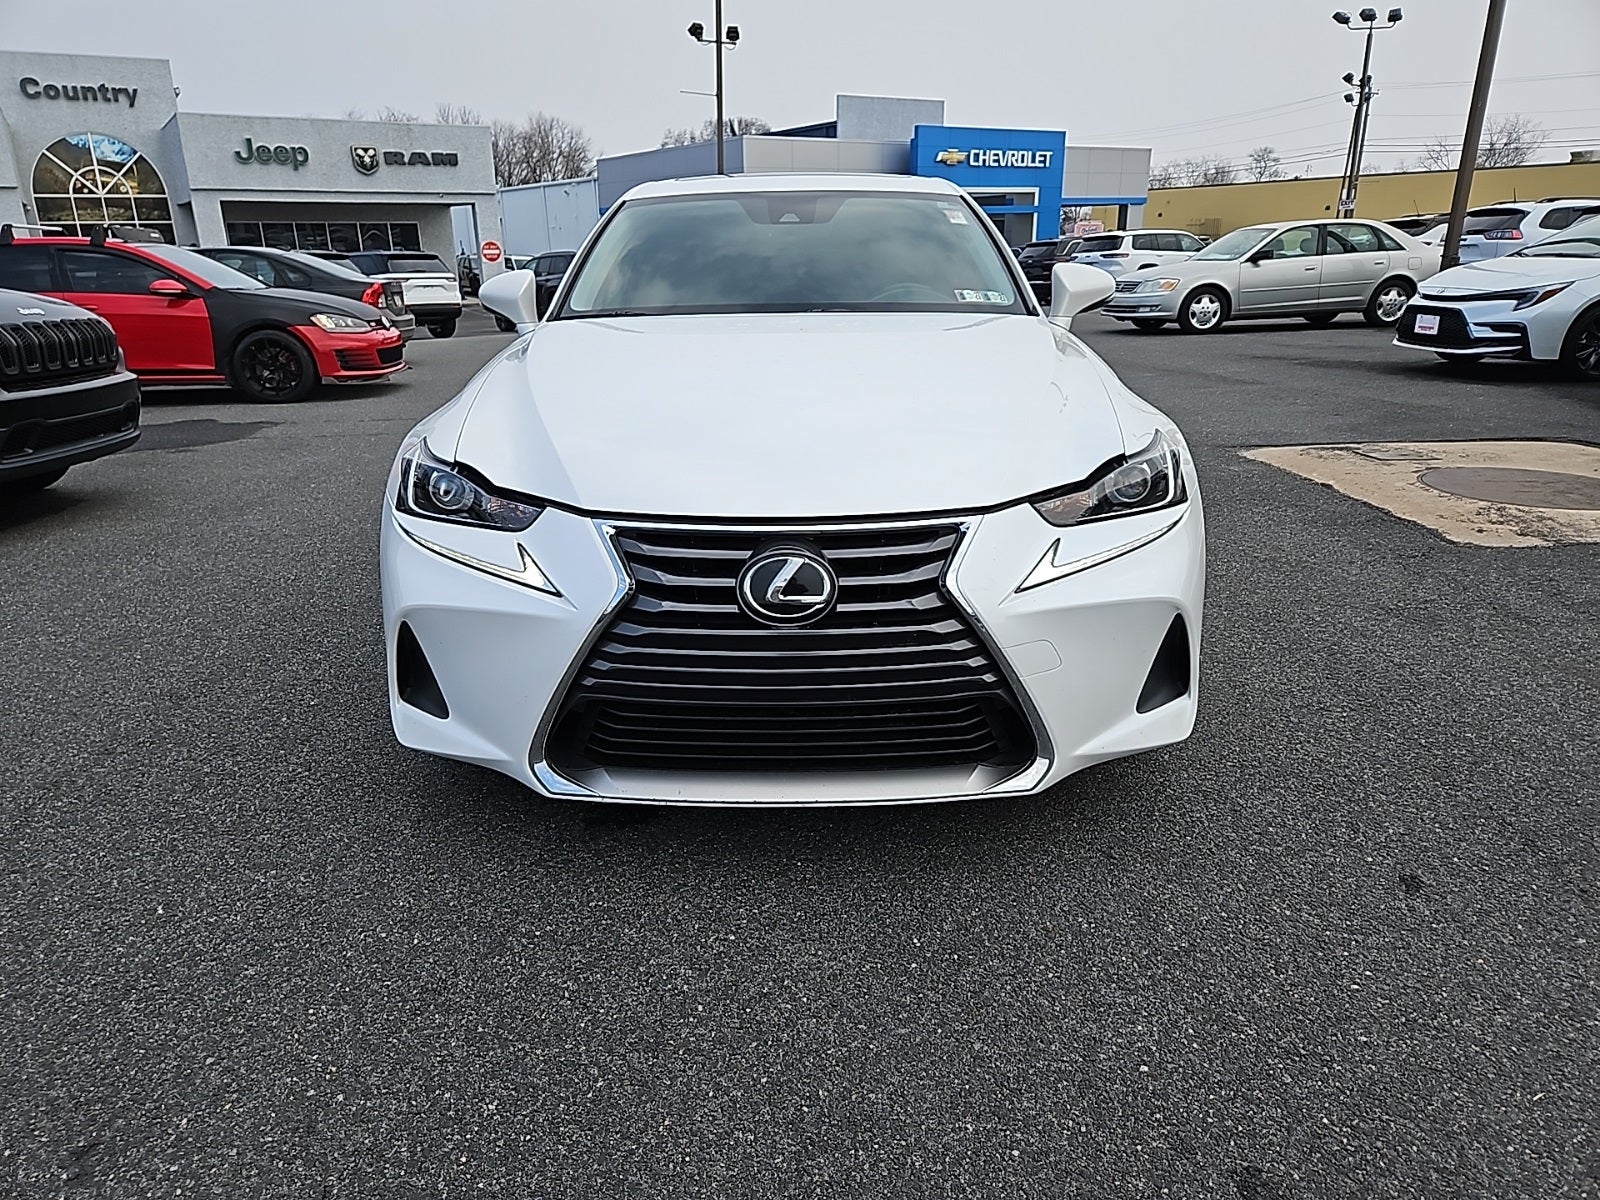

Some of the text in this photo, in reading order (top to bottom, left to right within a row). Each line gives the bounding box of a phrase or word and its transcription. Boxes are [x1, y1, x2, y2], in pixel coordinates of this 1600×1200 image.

[19, 77, 138, 108] Country
[234, 137, 310, 171] Jeep
[383, 151, 459, 167] RAM
[969, 149, 1054, 168] CHEVROLET
